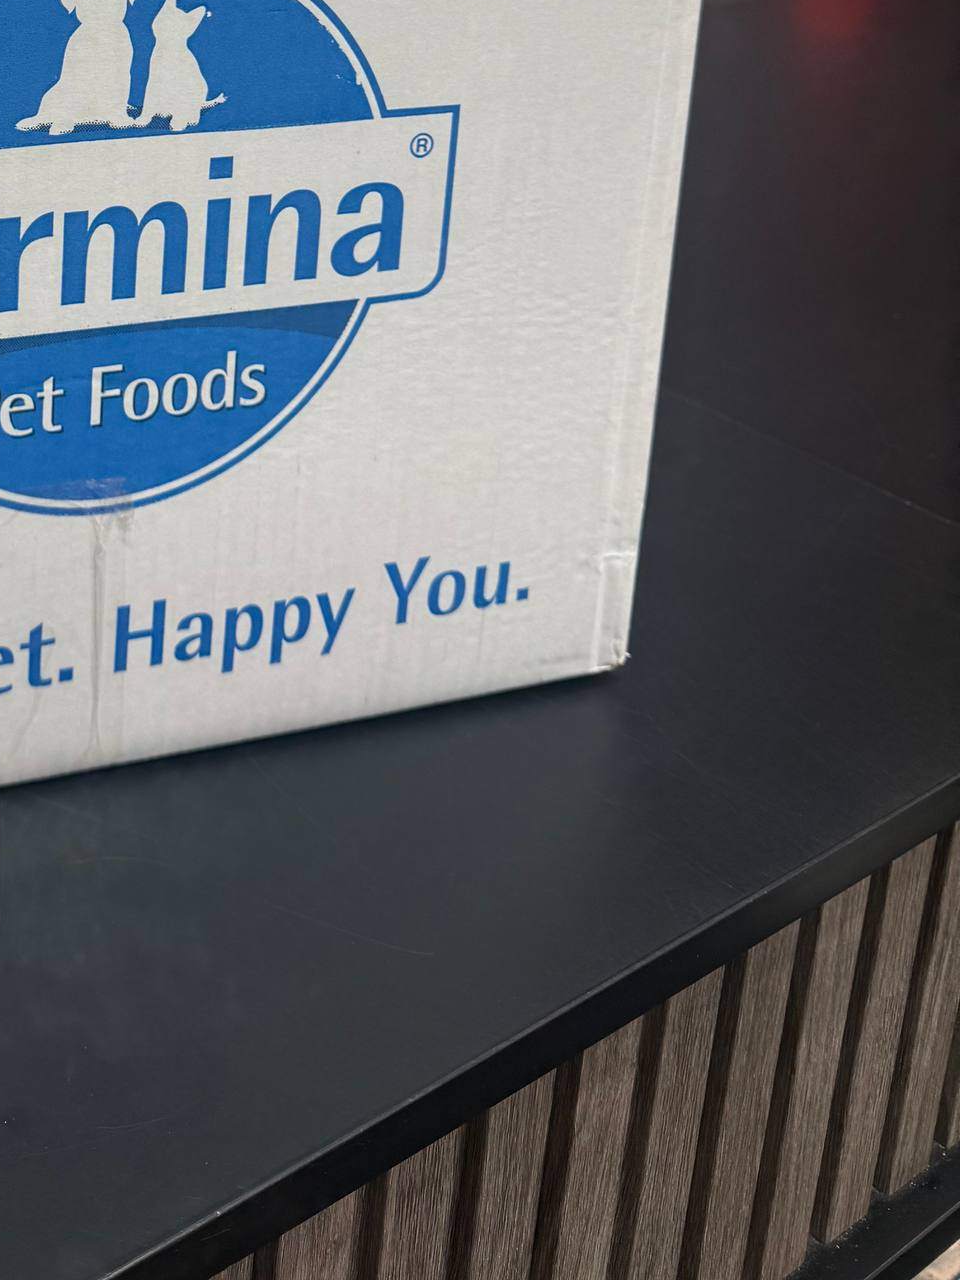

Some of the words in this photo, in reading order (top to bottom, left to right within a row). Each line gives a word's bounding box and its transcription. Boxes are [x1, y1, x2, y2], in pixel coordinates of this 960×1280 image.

[90, 350, 266, 426] Foods
[113, 587, 356, 674] Happy
[384, 556, 530, 625] You.
